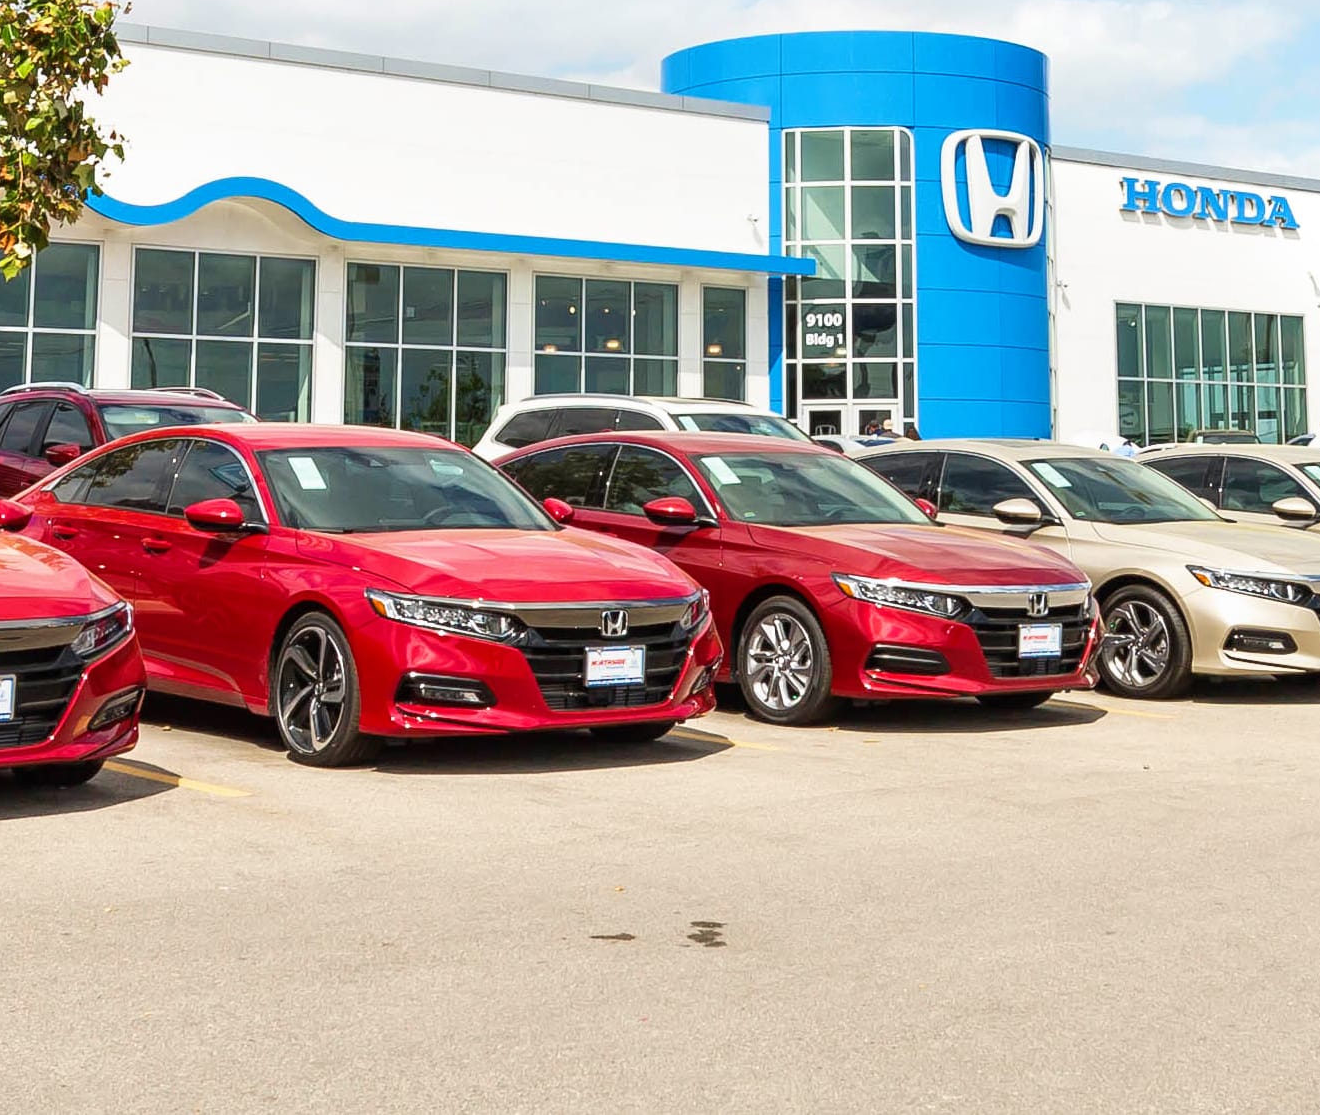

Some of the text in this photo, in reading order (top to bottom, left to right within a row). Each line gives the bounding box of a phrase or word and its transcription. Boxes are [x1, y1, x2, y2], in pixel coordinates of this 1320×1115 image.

[1120, 176, 1301, 231] HONDA
[805, 313, 843, 327] 9100
[805, 333, 843, 348] Bldg 1
